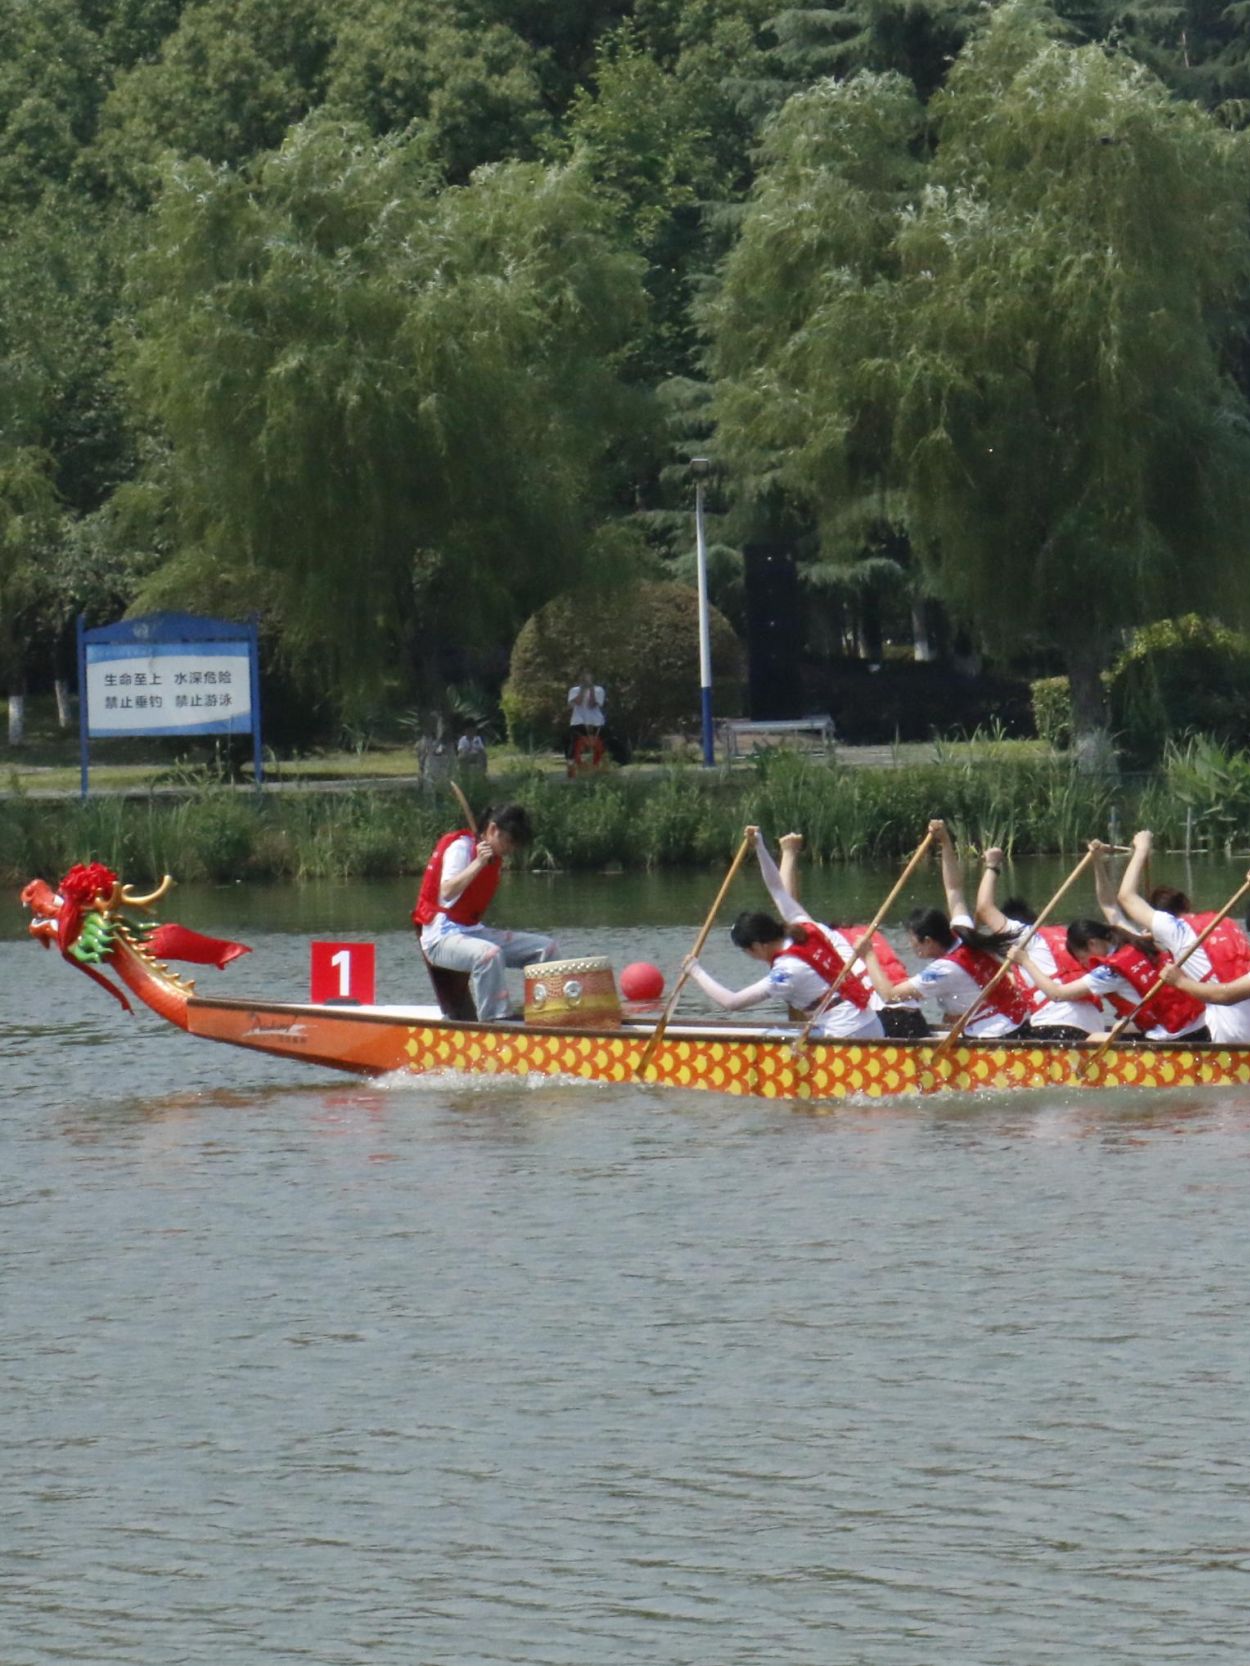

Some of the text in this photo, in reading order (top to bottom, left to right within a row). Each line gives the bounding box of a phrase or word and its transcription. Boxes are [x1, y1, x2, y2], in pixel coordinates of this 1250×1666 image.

[104, 670, 232, 687] 生命至上 水深危险
[105, 693, 233, 709] 禁止垂钓 禁止游泳
[331, 949, 350, 997] 1
